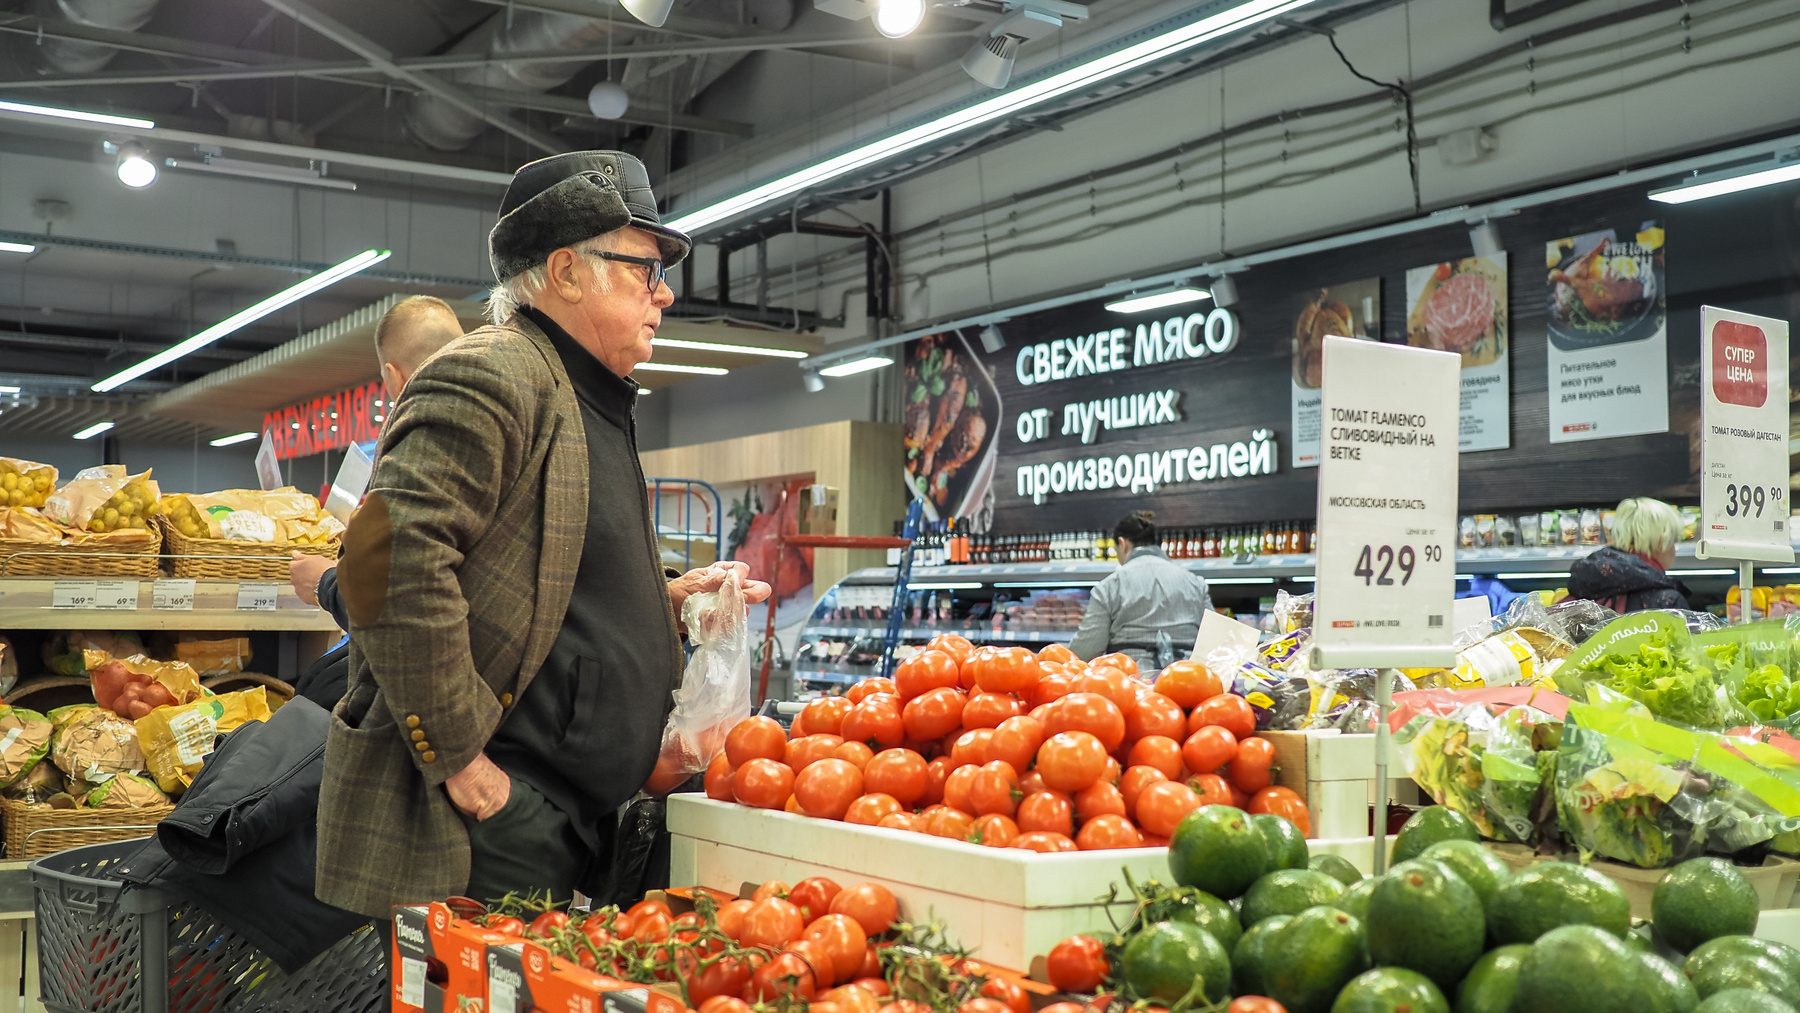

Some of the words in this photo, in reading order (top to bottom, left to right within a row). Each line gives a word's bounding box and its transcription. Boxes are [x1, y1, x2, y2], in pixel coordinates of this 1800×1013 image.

[1015, 327, 1127, 386] СВЕЖЕЕ
[1133, 307, 1236, 367] МЯСО
[1725, 345, 1755, 364] СУПЕР
[1560, 359, 1617, 374] Питательное
[1727, 365, 1754, 383] ЦЕНА
[1561, 378, 1582, 388] мясо
[1583, 375, 1603, 387] утки
[1561, 393, 1576, 403] для
[1578, 388, 1614, 402] вкусных
[1616, 385, 1641, 395] блюд
[1016, 406, 1048, 443] от
[1060, 389, 1177, 445] лучших
[1331, 408, 1368, 423] ТОМАТ
[1371, 411, 1426, 428] FLAMENCO
[262, 396, 333, 460] СВЕЖЕЕ
[1330, 427, 1417, 446] СЛИВОВИДНЫЙ
[1420, 433, 1435, 447] НА
[1711, 425, 1730, 435] ТОМАТ
[1730, 428, 1755, 439] РОЗОВЫЙ
[1756, 431, 1782, 442] ДАГЕСТАН
[1330, 446, 1361, 461] ВЕТКЕ
[1017, 428, 1272, 505] производителей
[1711, 471, 1722, 479] Цена
[1329, 497, 1387, 508] МОСКОВСКАЯ
[1388, 499, 1426, 510] ОБЛАСТЬ
[1726, 483, 1766, 518] 399
[1771, 487, 1782, 501] 90
[1354, 544, 1416, 586] 429
[1425, 545, 1442, 562] 90
[181, 717, 206, 757] FRESH
